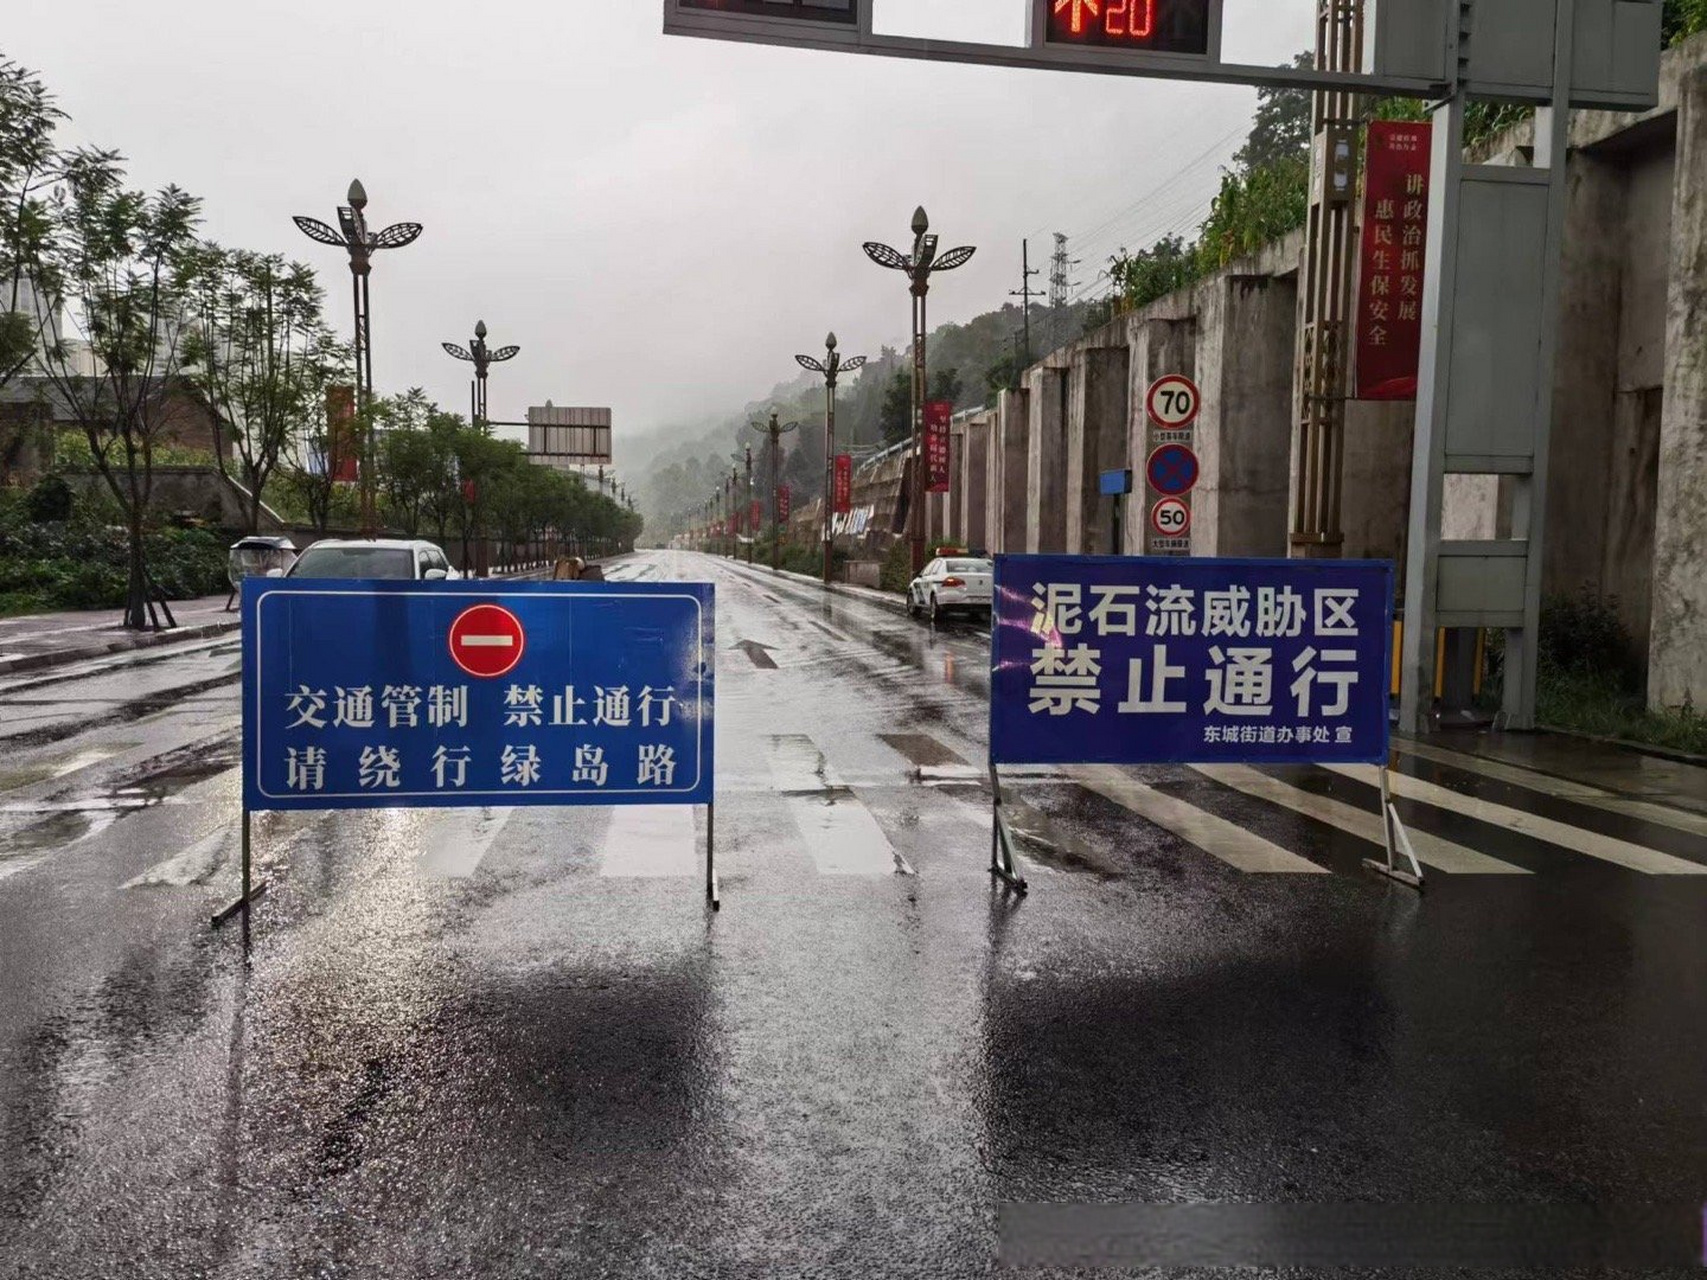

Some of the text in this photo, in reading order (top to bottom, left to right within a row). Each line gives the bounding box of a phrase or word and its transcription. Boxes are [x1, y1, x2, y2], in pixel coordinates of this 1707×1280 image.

[1106, 0, 1151, 35] 20
[1397, 173, 1425, 321] 讲政治抓发展
[1368, 199, 1395, 346] 惠民生保安全
[1161, 390, 1190, 414] 70
[1160, 510, 1184, 525] 50
[1030, 581, 1360, 637] 泥石流威胁区
[1028, 643, 1359, 717] 禁止通行
[285, 684, 676, 730] 交通管制 禁止通行
[1203, 726, 1353, 743] 东城街道办事处 宣
[285, 744, 676, 791] 请绕行绿岛路
